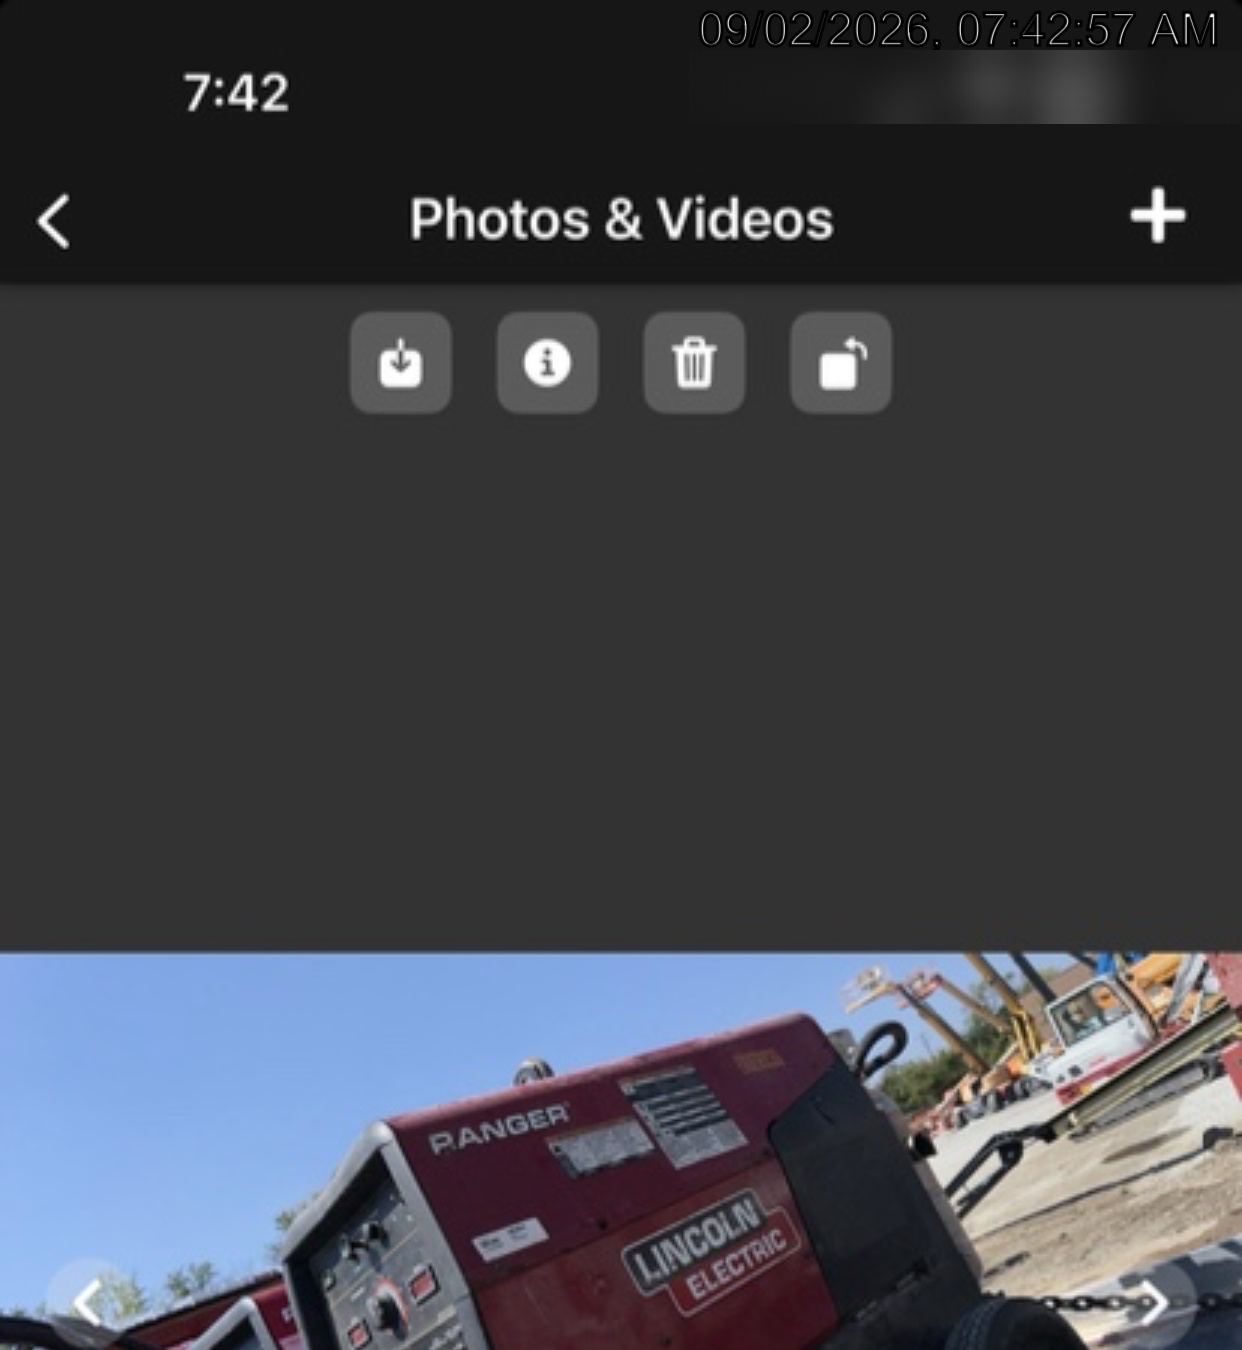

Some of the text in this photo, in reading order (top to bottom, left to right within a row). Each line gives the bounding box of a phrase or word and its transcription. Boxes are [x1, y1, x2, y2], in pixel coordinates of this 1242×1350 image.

[183, 72, 289, 112] 7:42
[411, 194, 834, 241] Photos & Videos
[428, 1103, 570, 1156] RANGER
[634, 1198, 761, 1286] LINCOLN
[685, 1228, 787, 1299] ELECTRIC
